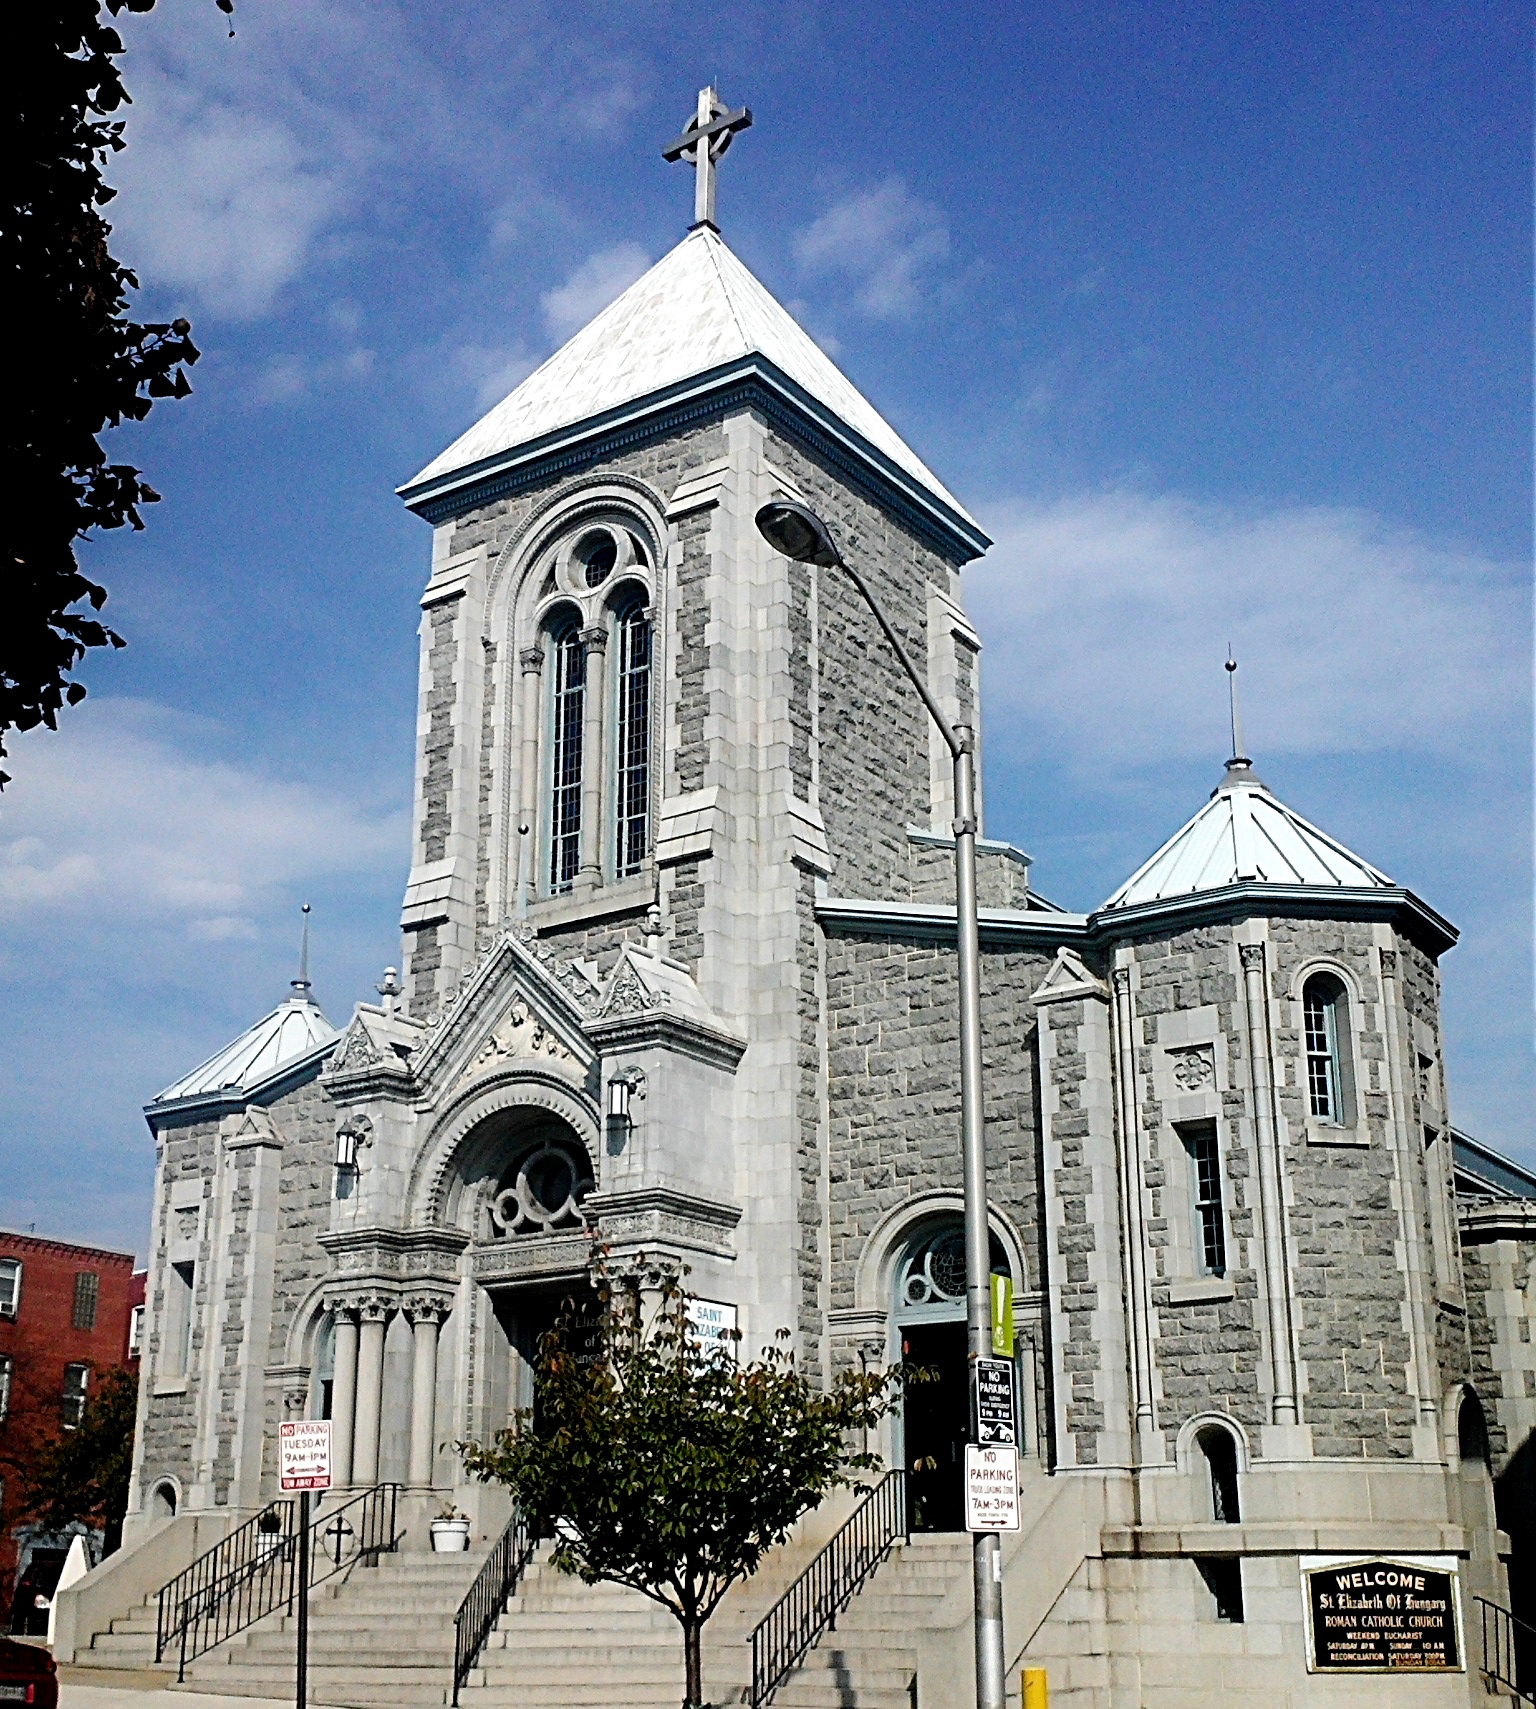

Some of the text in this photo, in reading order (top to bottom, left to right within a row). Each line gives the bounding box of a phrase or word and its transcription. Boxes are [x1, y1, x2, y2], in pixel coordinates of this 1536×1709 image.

[697, 1306, 722, 1322] SAINT
[989, 1371, 1000, 1382] NO
[980, 1382, 1010, 1395] PARKING
[282, 1424, 328, 1436] NO PARKING
[284, 1438, 327, 1449] TUESDAY
[285, 1452, 327, 1462] 9AM-1PM
[984, 1451, 997, 1463] NO
[970, 1468, 1013, 1481] PARKING
[972, 1498, 1013, 1510] 7AM-3PM
[1336, 1572, 1425, 1590] WELCOME
[1336, 1593, 1383, 1610] Elizabeth
[1404, 1593, 1446, 1611] Hungary
[1325, 1616, 1443, 1627] ROMAN CATHOLIC CHURCH
[1346, 1632, 1423, 1640] WEEKEND EUCHARIST
[1327, 1642, 1357, 1650] SATURDAY
[1389, 1642, 1412, 1650] SUNDAY
[1388, 1652, 1422, 1660] SATURDAY
